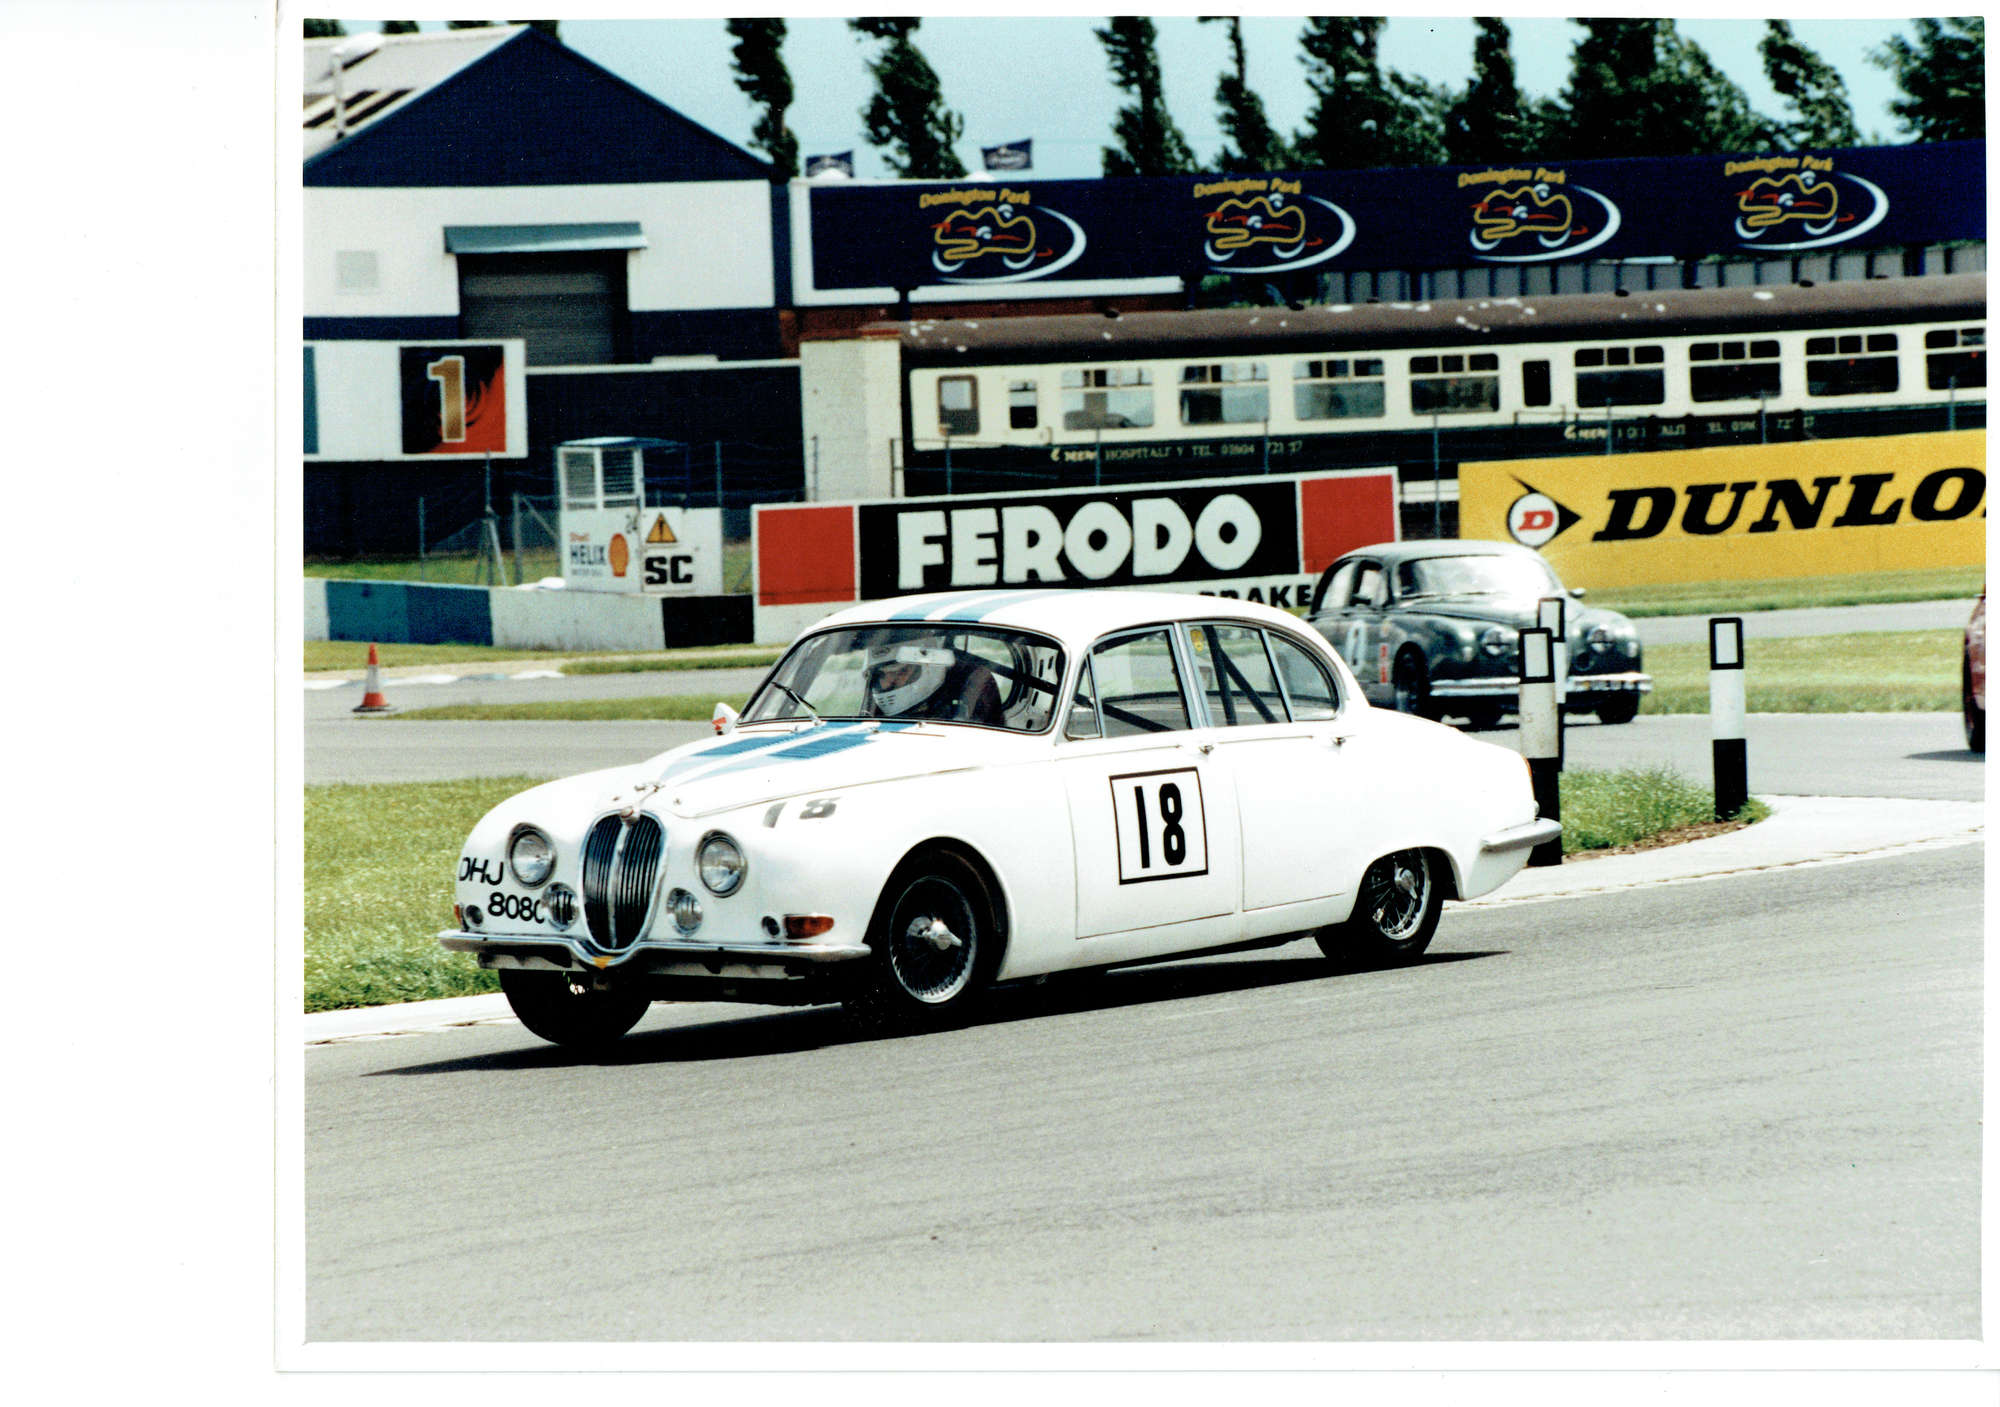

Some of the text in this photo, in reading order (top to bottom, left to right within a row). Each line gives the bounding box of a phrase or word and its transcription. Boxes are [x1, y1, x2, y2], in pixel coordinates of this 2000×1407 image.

[1458, 166, 1566, 187] Donington Park
[1724, 155, 1832, 176] Donington Park
[919, 188, 1030, 208] Donington Park
[1194, 177, 1302, 198] Donington Park
[427, 355, 466, 443] 1
[1592, 467, 1986, 542] DUNLO
[570, 544, 606, 566] HELIX
[897, 493, 1262, 589] FERODO
[645, 555, 693, 584] SC
[762, 797, 840, 829] 18
[1134, 782, 1186, 869] 18
